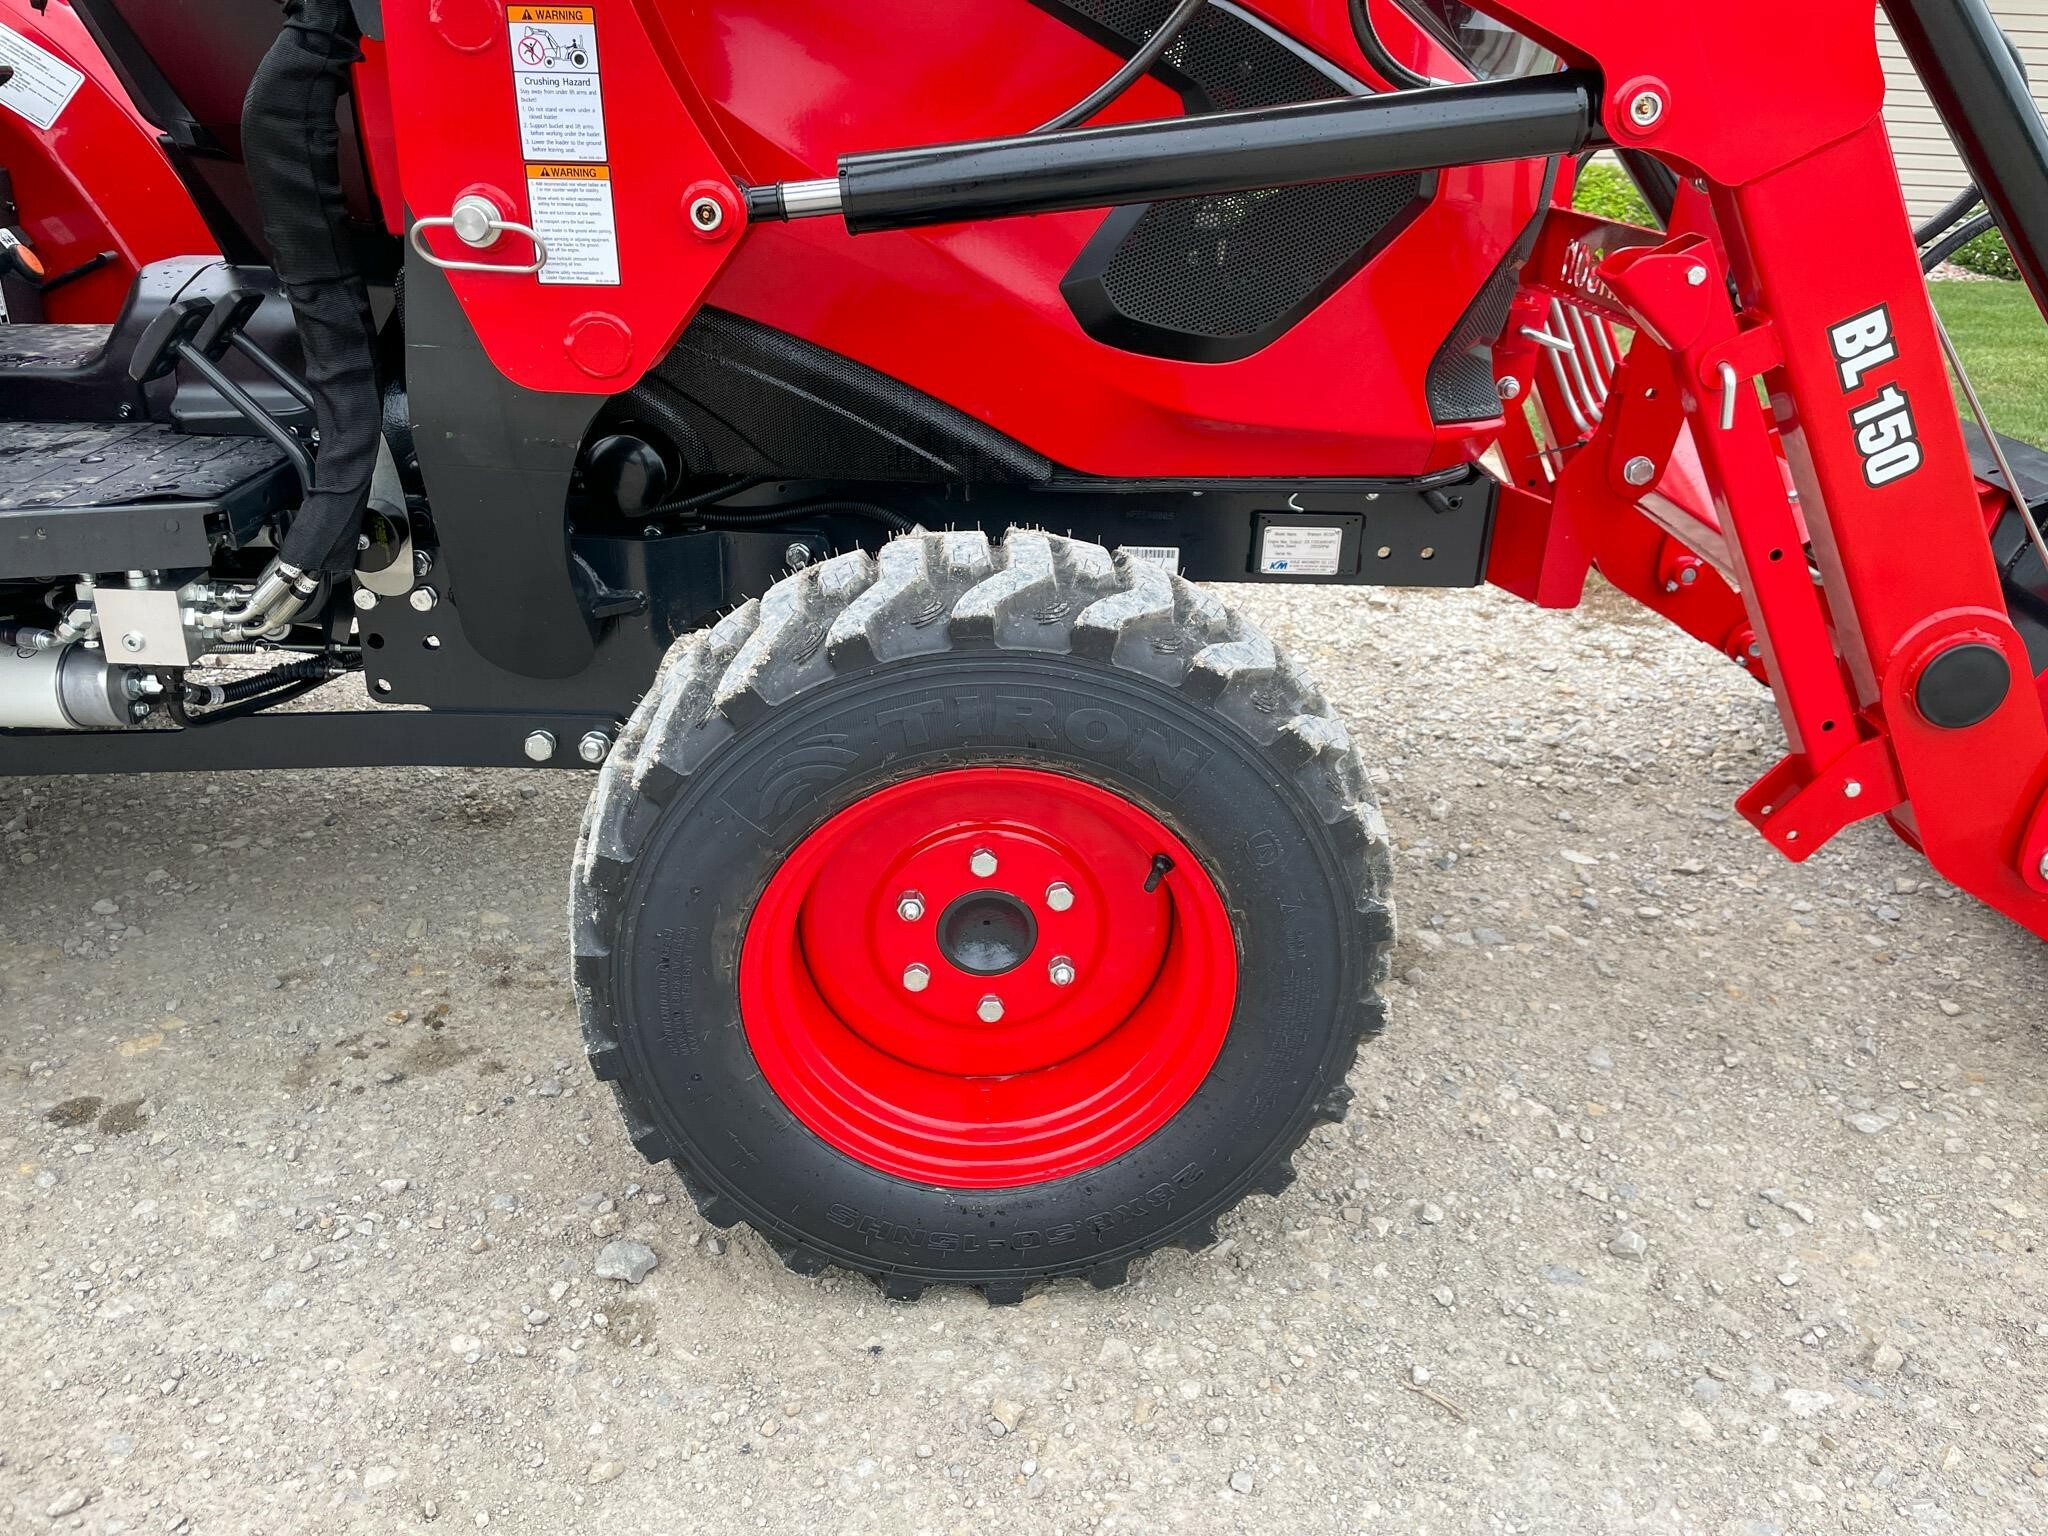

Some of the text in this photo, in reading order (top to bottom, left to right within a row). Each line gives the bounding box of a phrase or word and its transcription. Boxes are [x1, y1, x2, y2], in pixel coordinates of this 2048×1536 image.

[535, 9, 583, 21] WARNING
[524, 76, 591, 88] Crushing Hazard
[550, 167, 597, 178] WARNING
[1828, 303, 1923, 488] BL 150
[1269, 560, 1288, 570] KM
[876, 695, 1202, 788] TIRON
